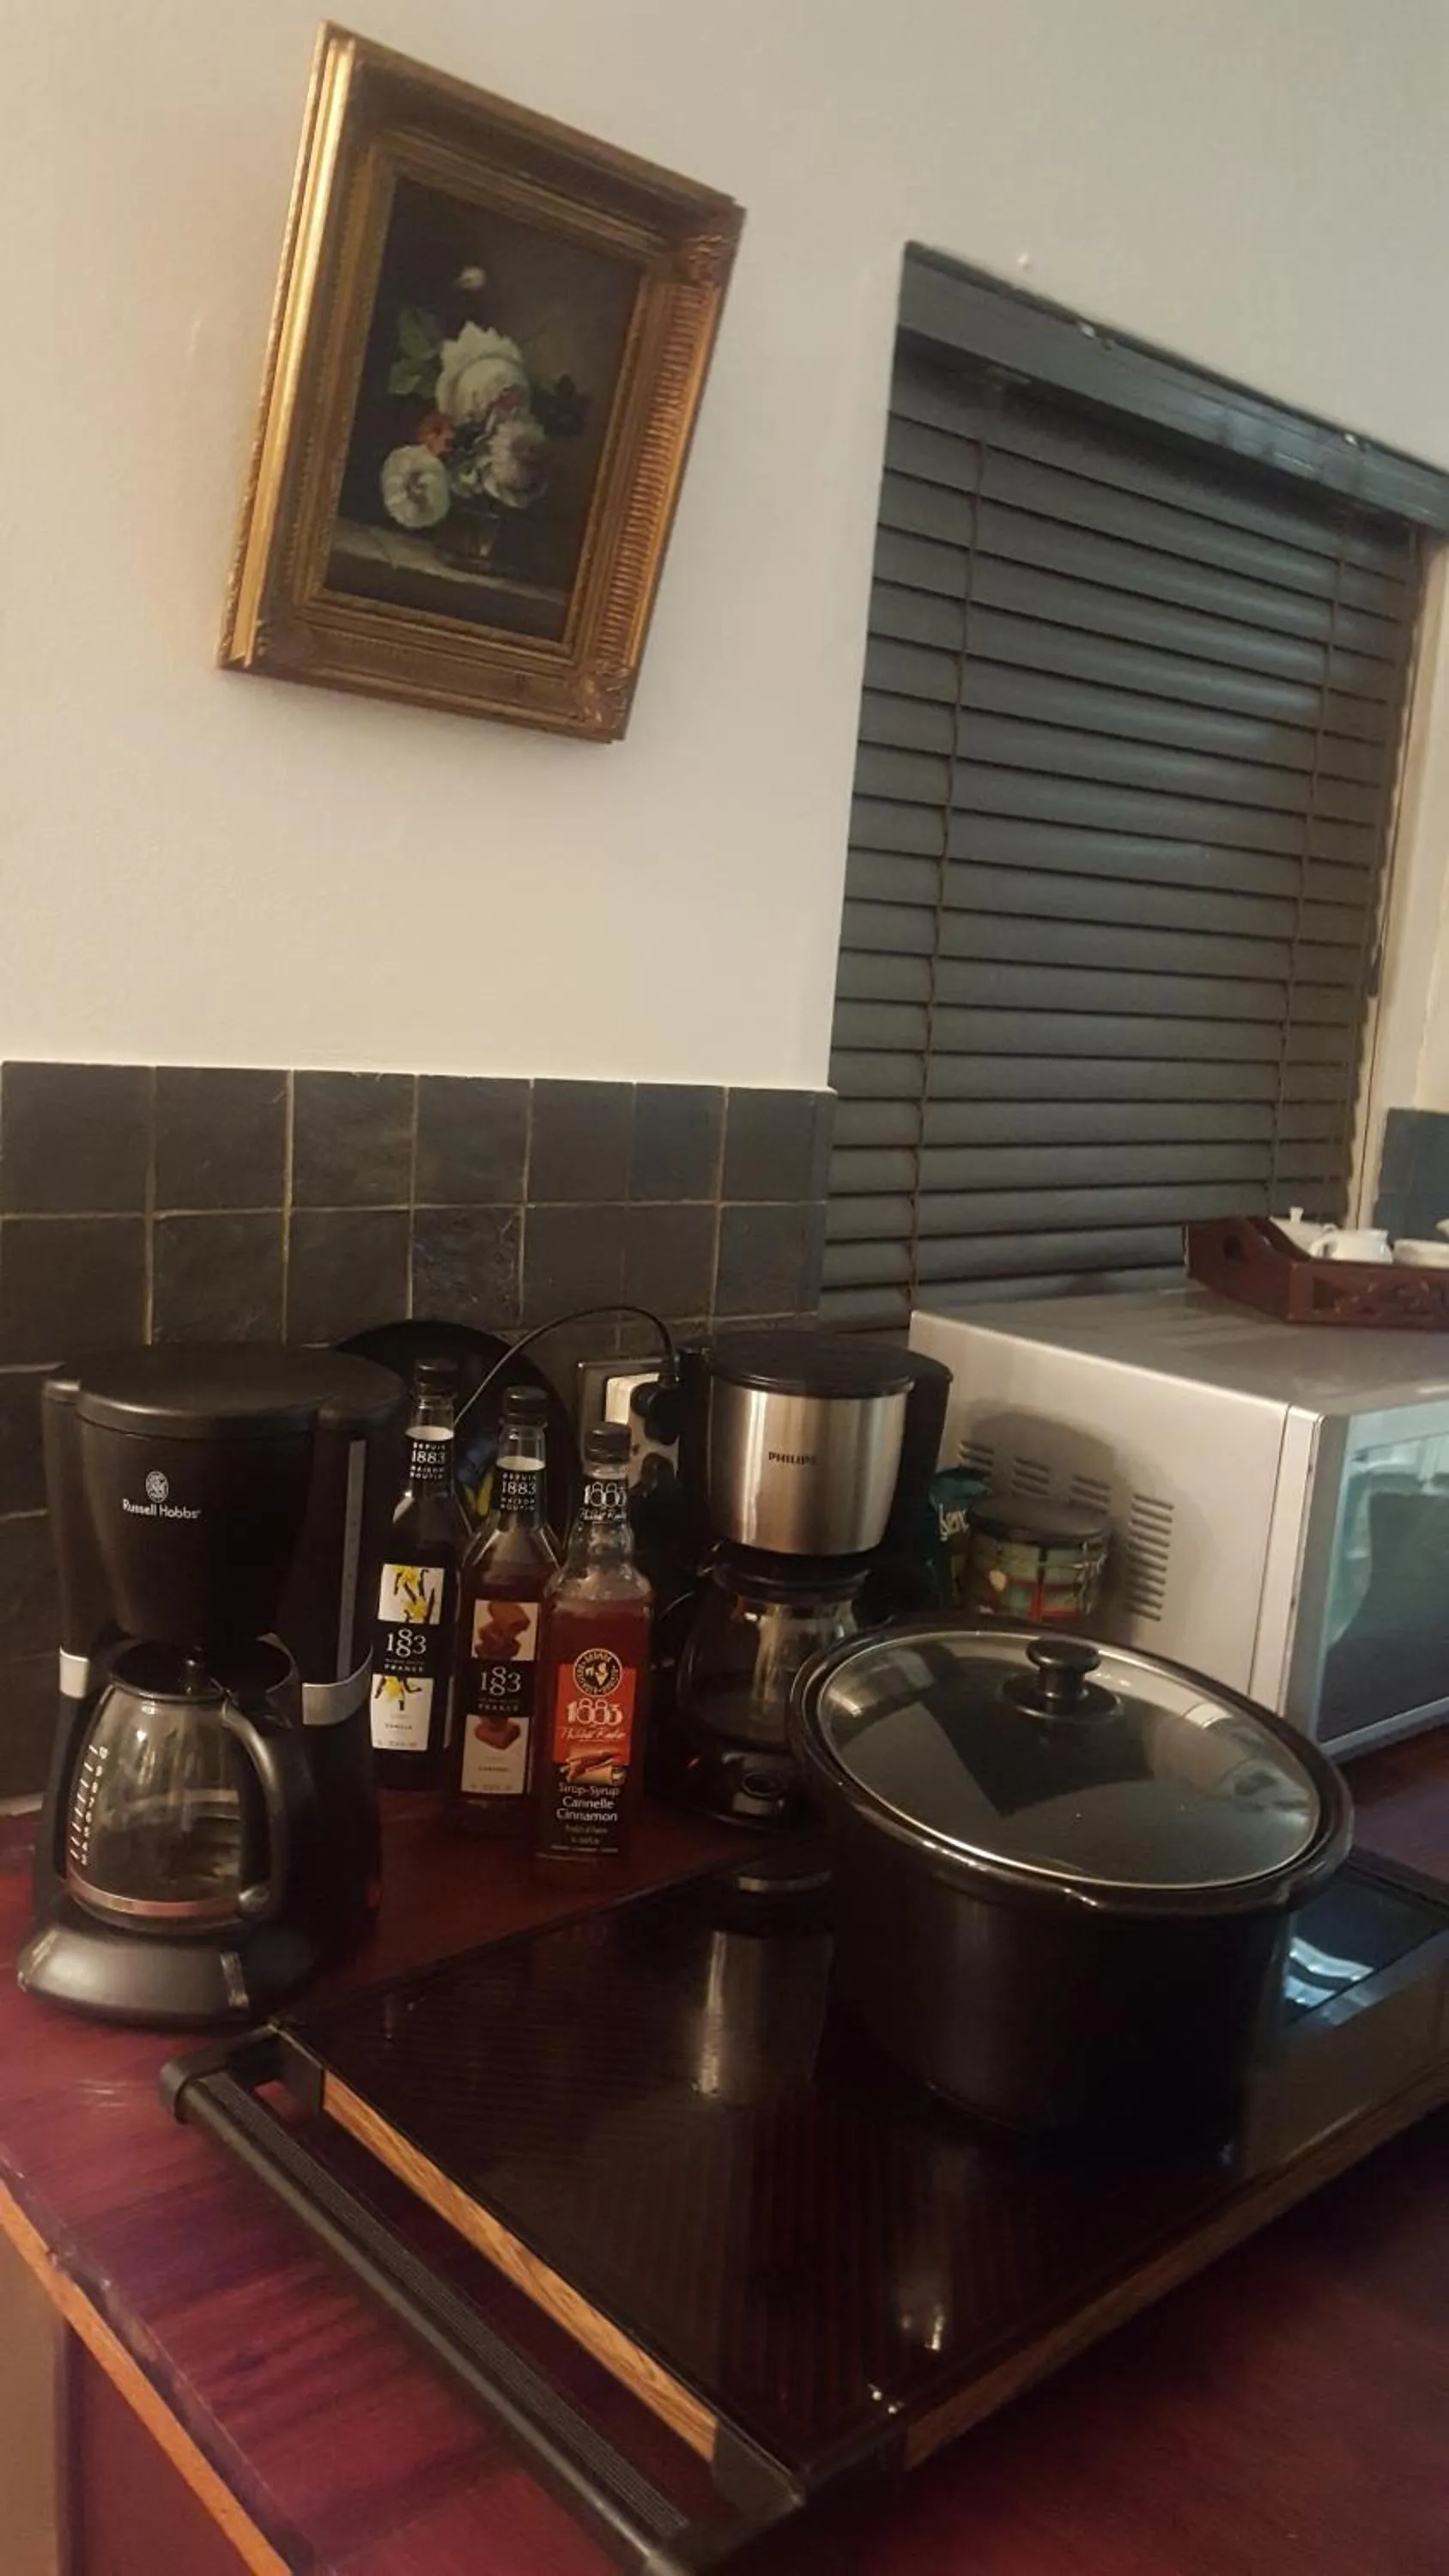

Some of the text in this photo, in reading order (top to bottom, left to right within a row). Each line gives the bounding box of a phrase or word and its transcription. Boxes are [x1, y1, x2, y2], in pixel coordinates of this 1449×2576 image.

[411, 1449, 446, 1465] 1883
[501, 1481, 537, 1496] 1883
[122, 1498, 198, 1519] Russell Hobbs
[555, 1808, 618, 1822] Cinnamon
